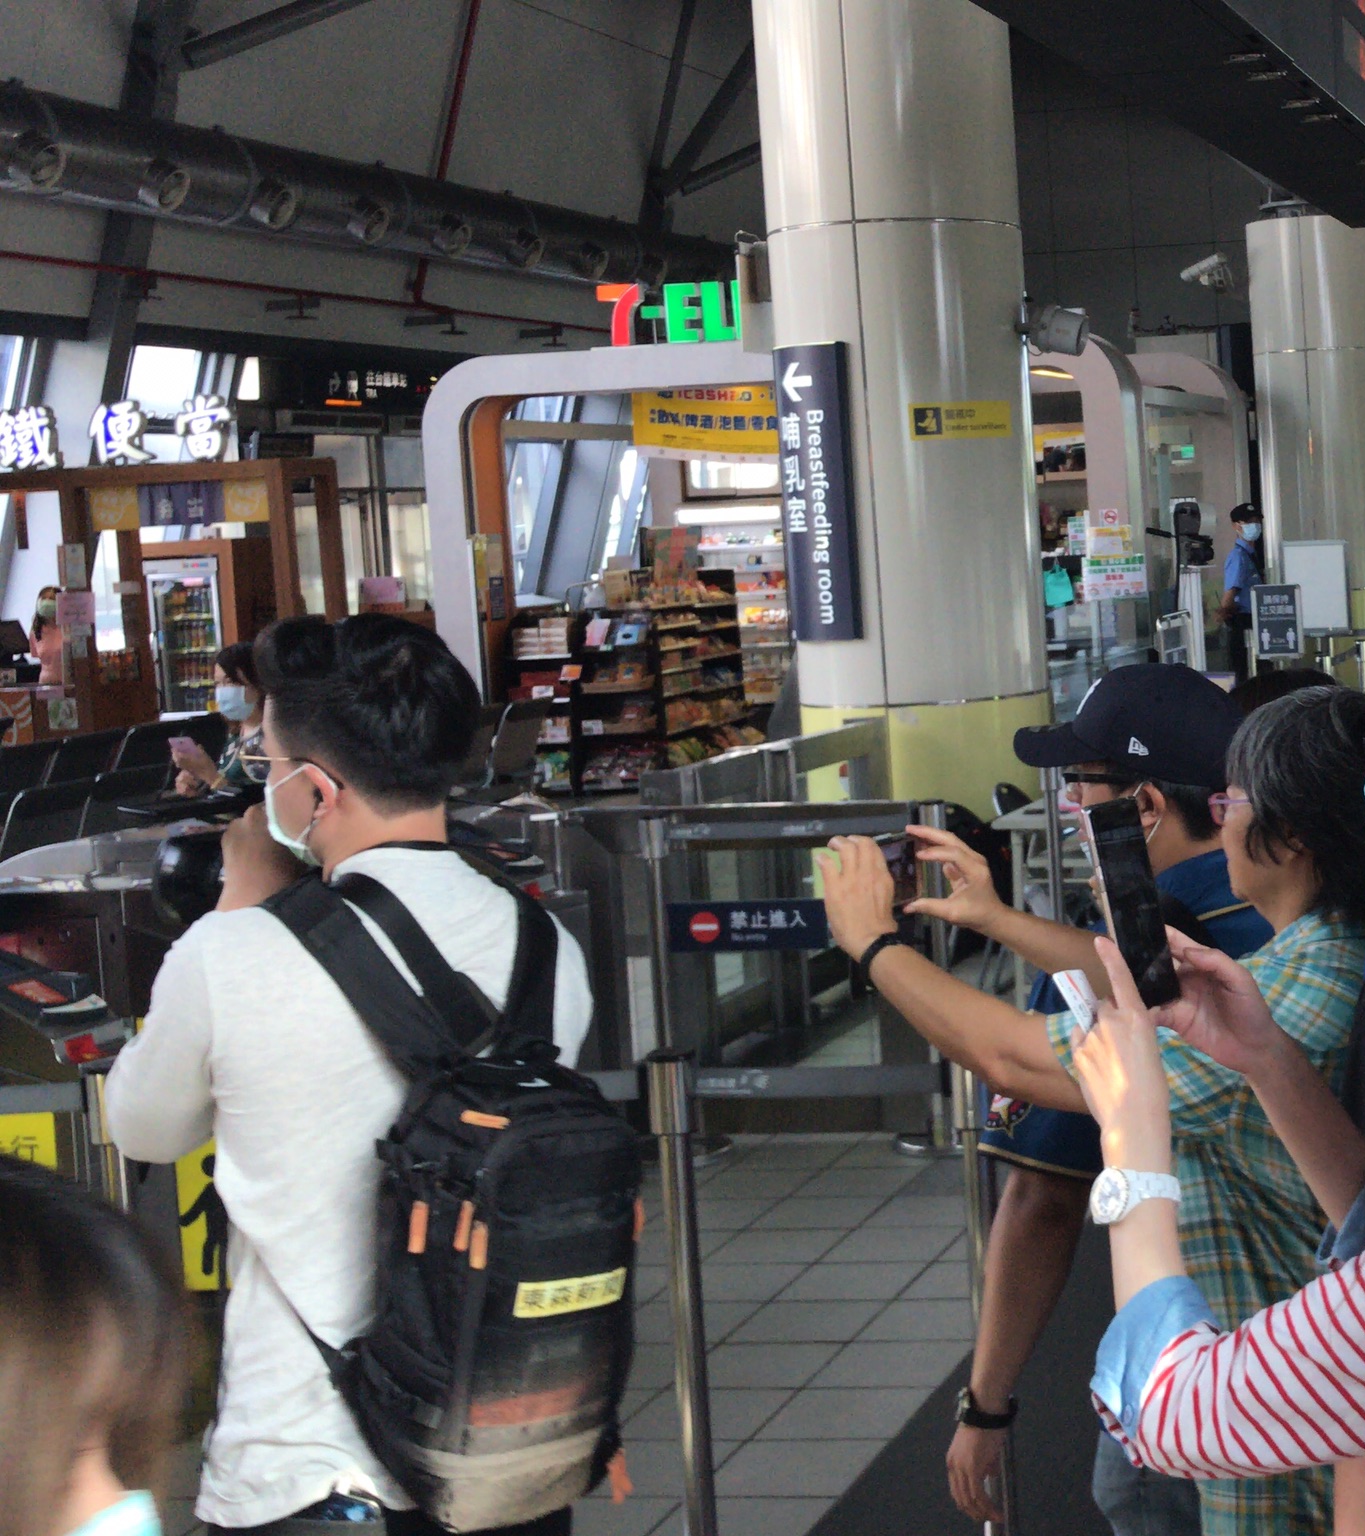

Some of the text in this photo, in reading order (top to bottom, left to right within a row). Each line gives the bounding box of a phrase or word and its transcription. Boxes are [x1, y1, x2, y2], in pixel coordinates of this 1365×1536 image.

[782, 412, 809, 533] 哺乳室
[806, 409, 835, 625] Breastfeeding room
[729, 908, 807, 930] 禁止進入
